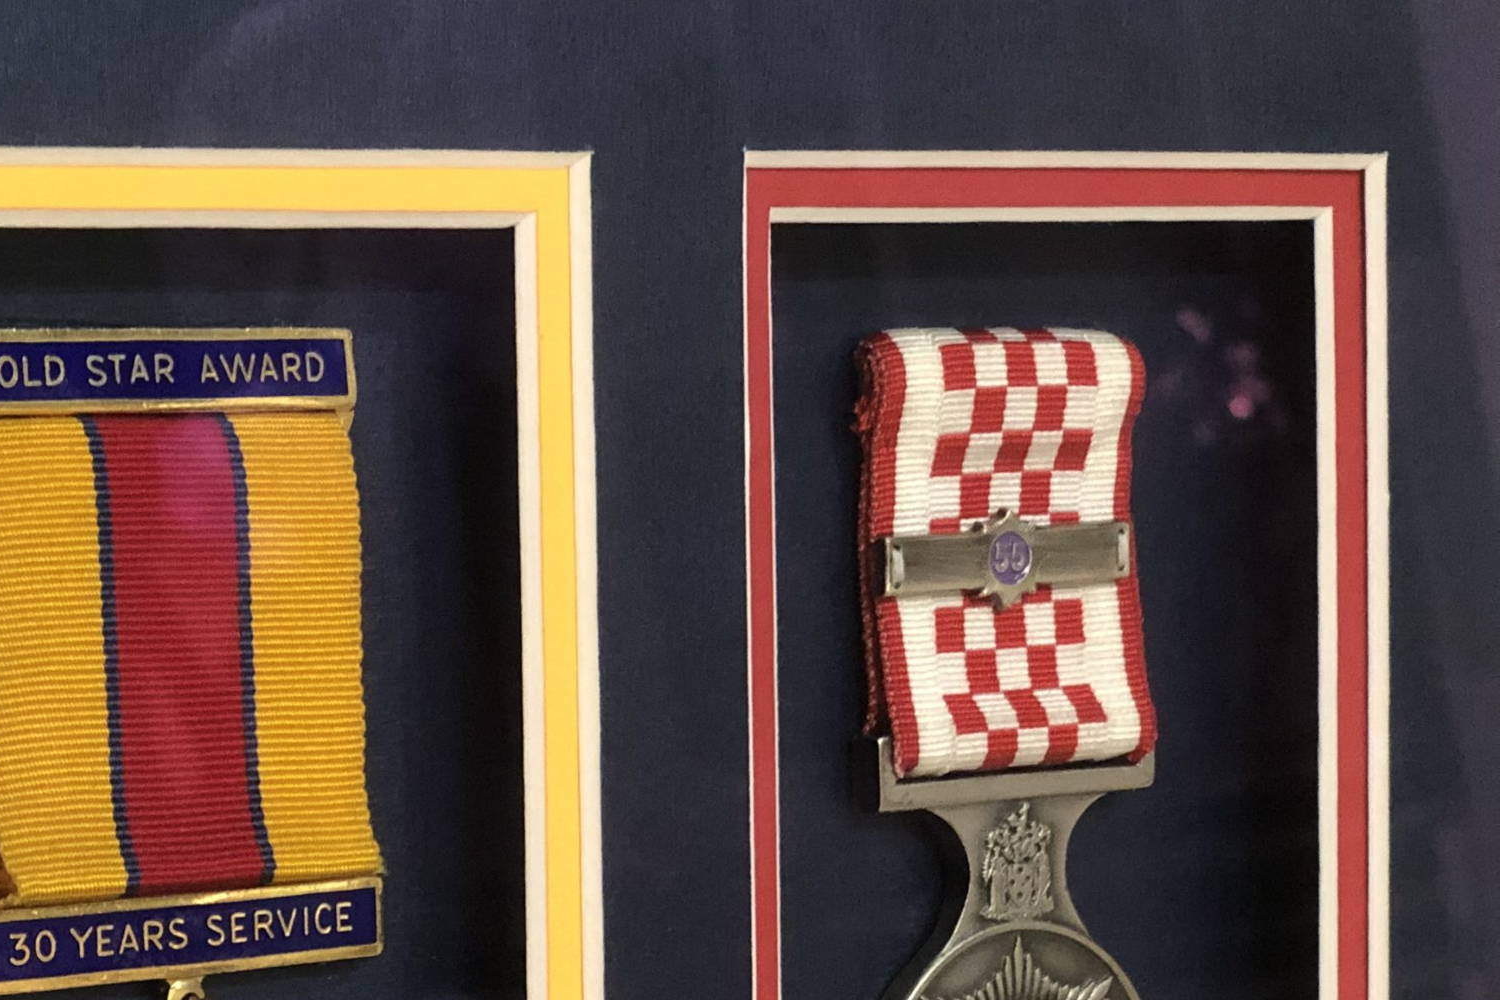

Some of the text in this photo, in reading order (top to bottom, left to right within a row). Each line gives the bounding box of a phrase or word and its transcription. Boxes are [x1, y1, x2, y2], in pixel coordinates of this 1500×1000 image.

[87, 352, 175, 387] STAR
[200, 351, 325, 384] AWARD
[9, 902, 353, 967] 30 YEARS SERVICE
